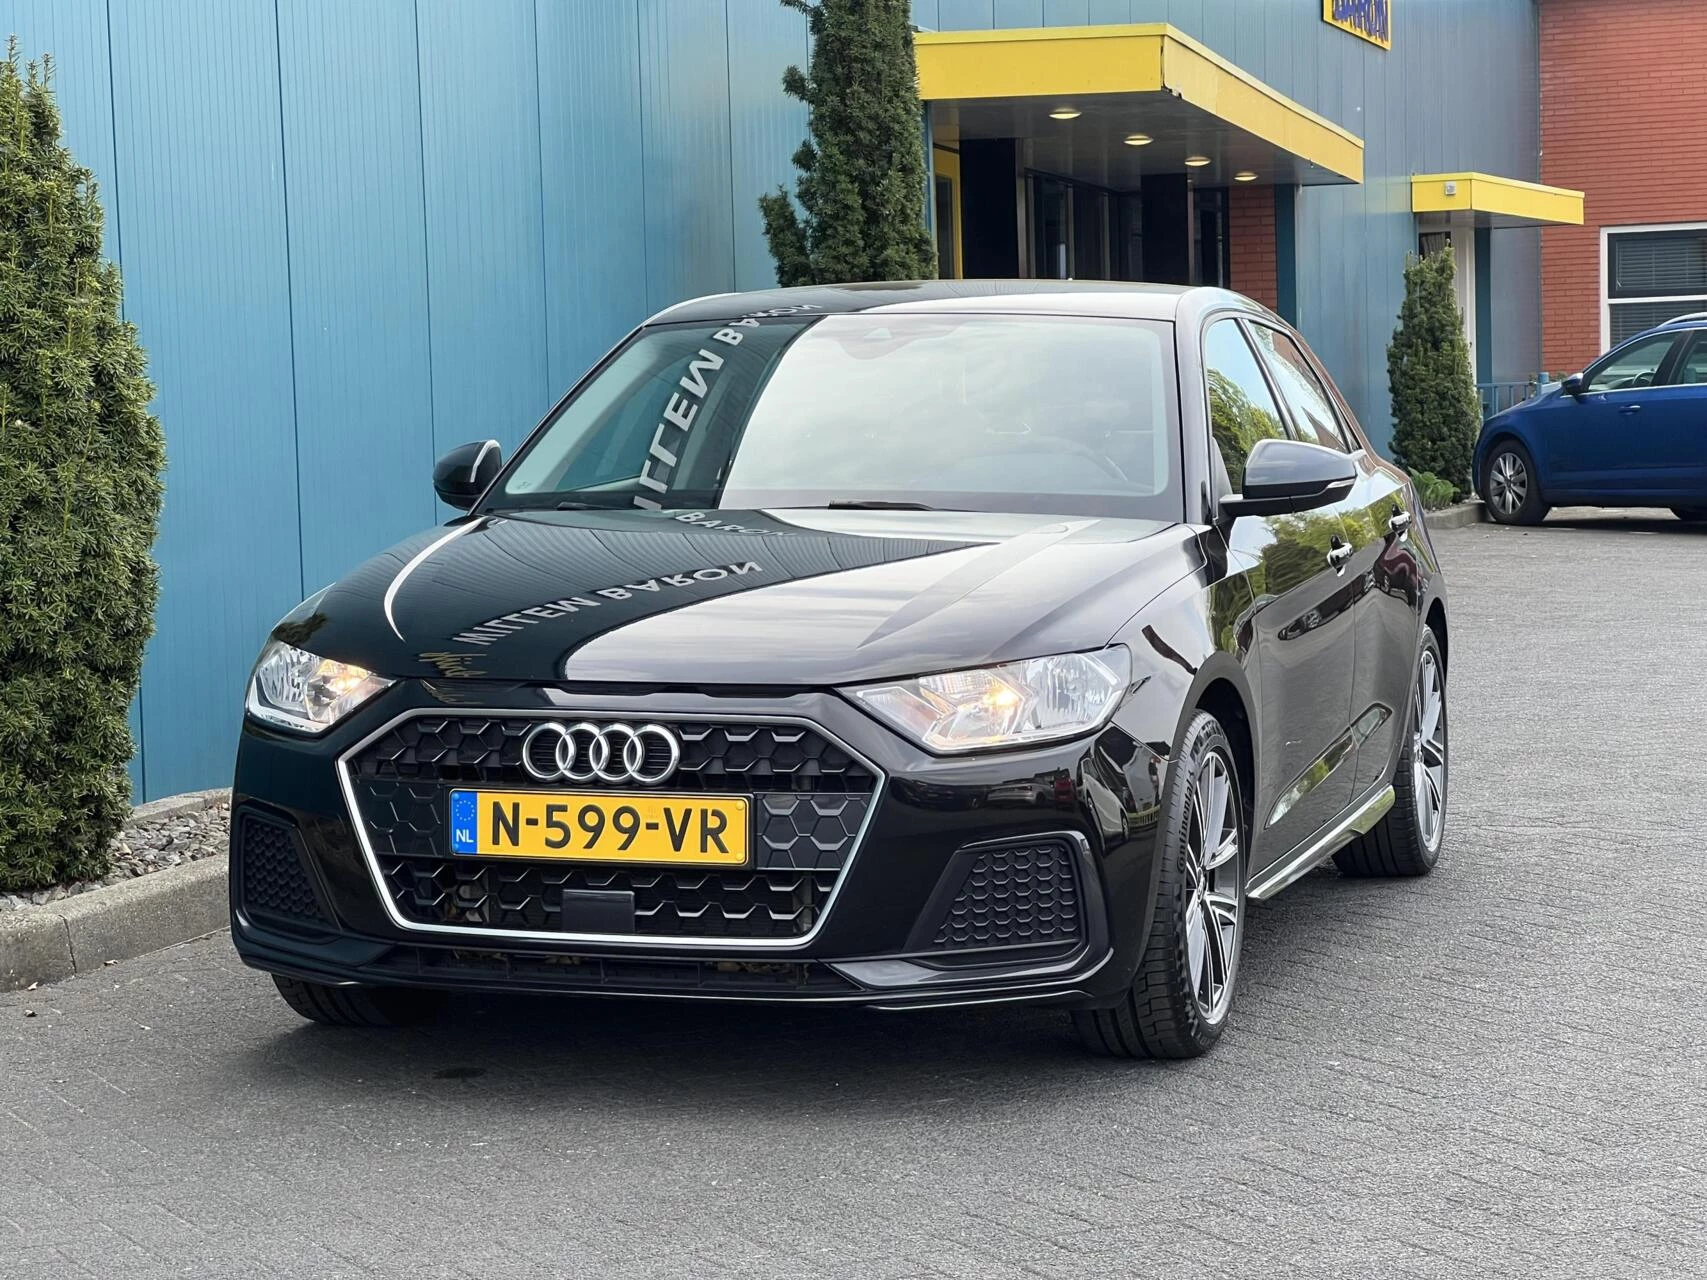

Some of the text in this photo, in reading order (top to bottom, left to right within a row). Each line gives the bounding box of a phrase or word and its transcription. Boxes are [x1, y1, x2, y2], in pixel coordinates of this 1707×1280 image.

[455, 828, 474, 843] NL
[490, 800, 730, 854] N-599-VR
[1176, 777, 1195, 875] Continental
